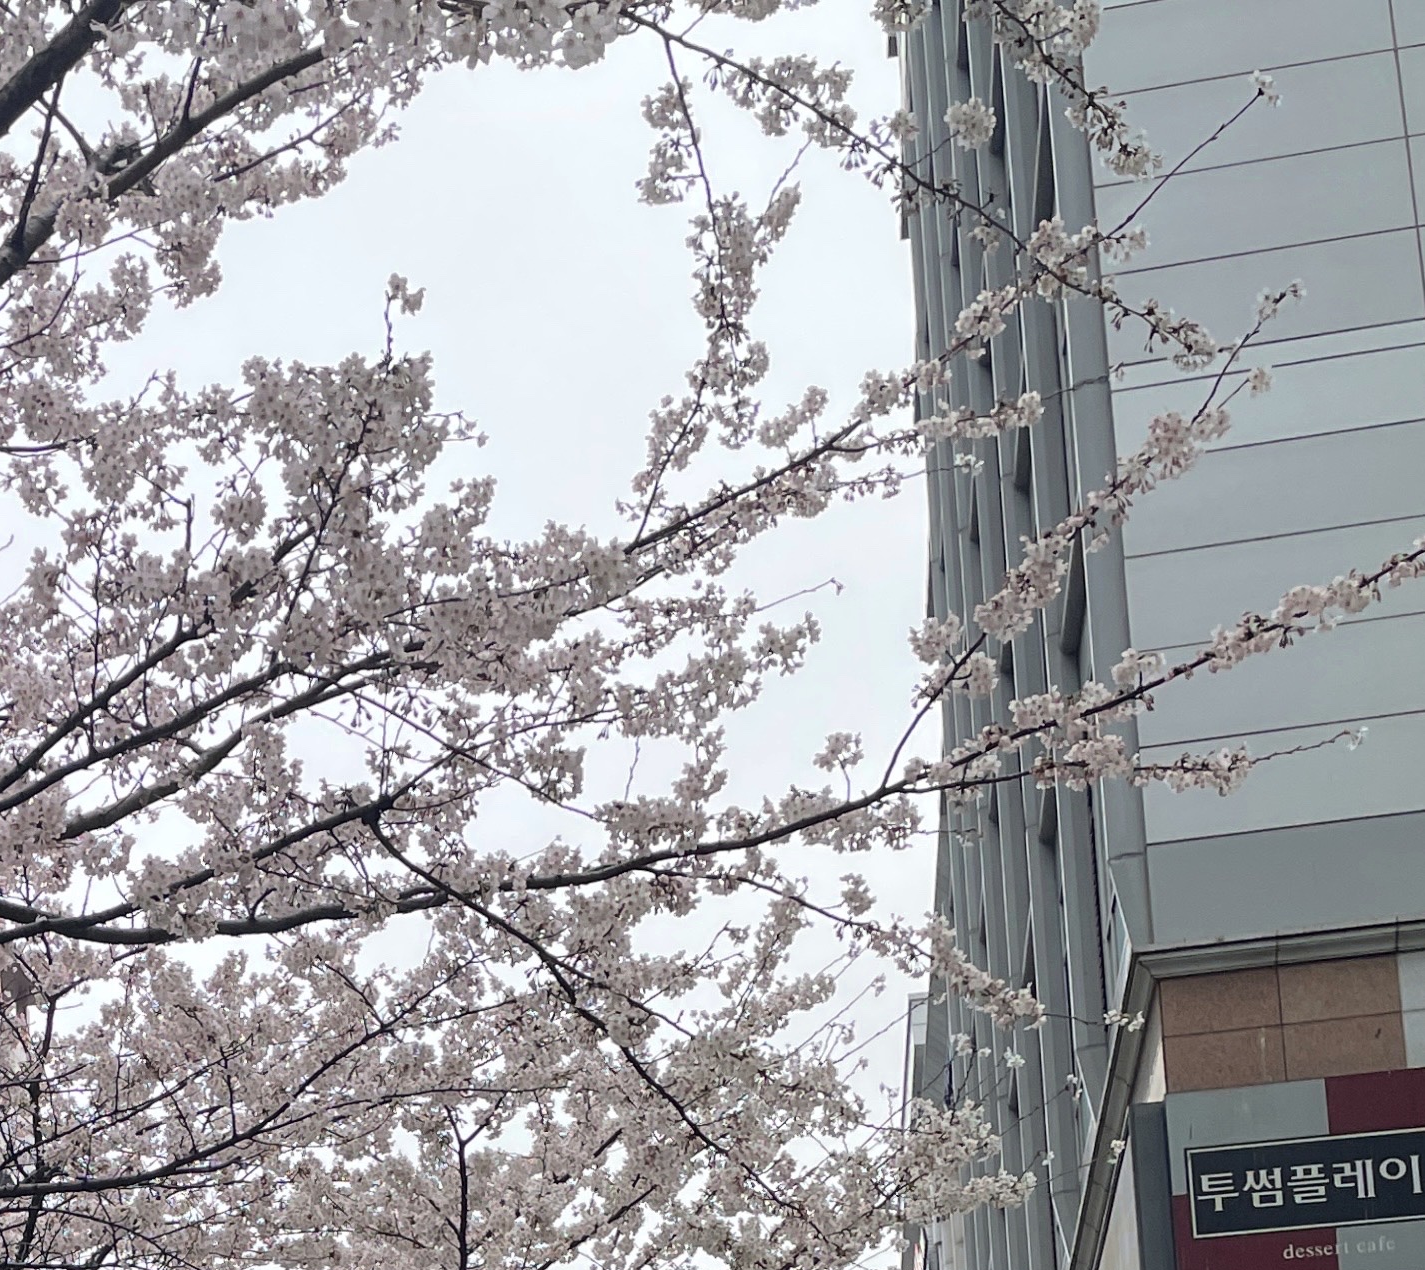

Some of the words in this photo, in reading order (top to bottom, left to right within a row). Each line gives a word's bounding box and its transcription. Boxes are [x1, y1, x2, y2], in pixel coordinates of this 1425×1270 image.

[1197, 1154, 1423, 1212] 투썸플레이
[1282, 1240, 1349, 1260] dessert
[1356, 1235, 1396, 1254] cafe
